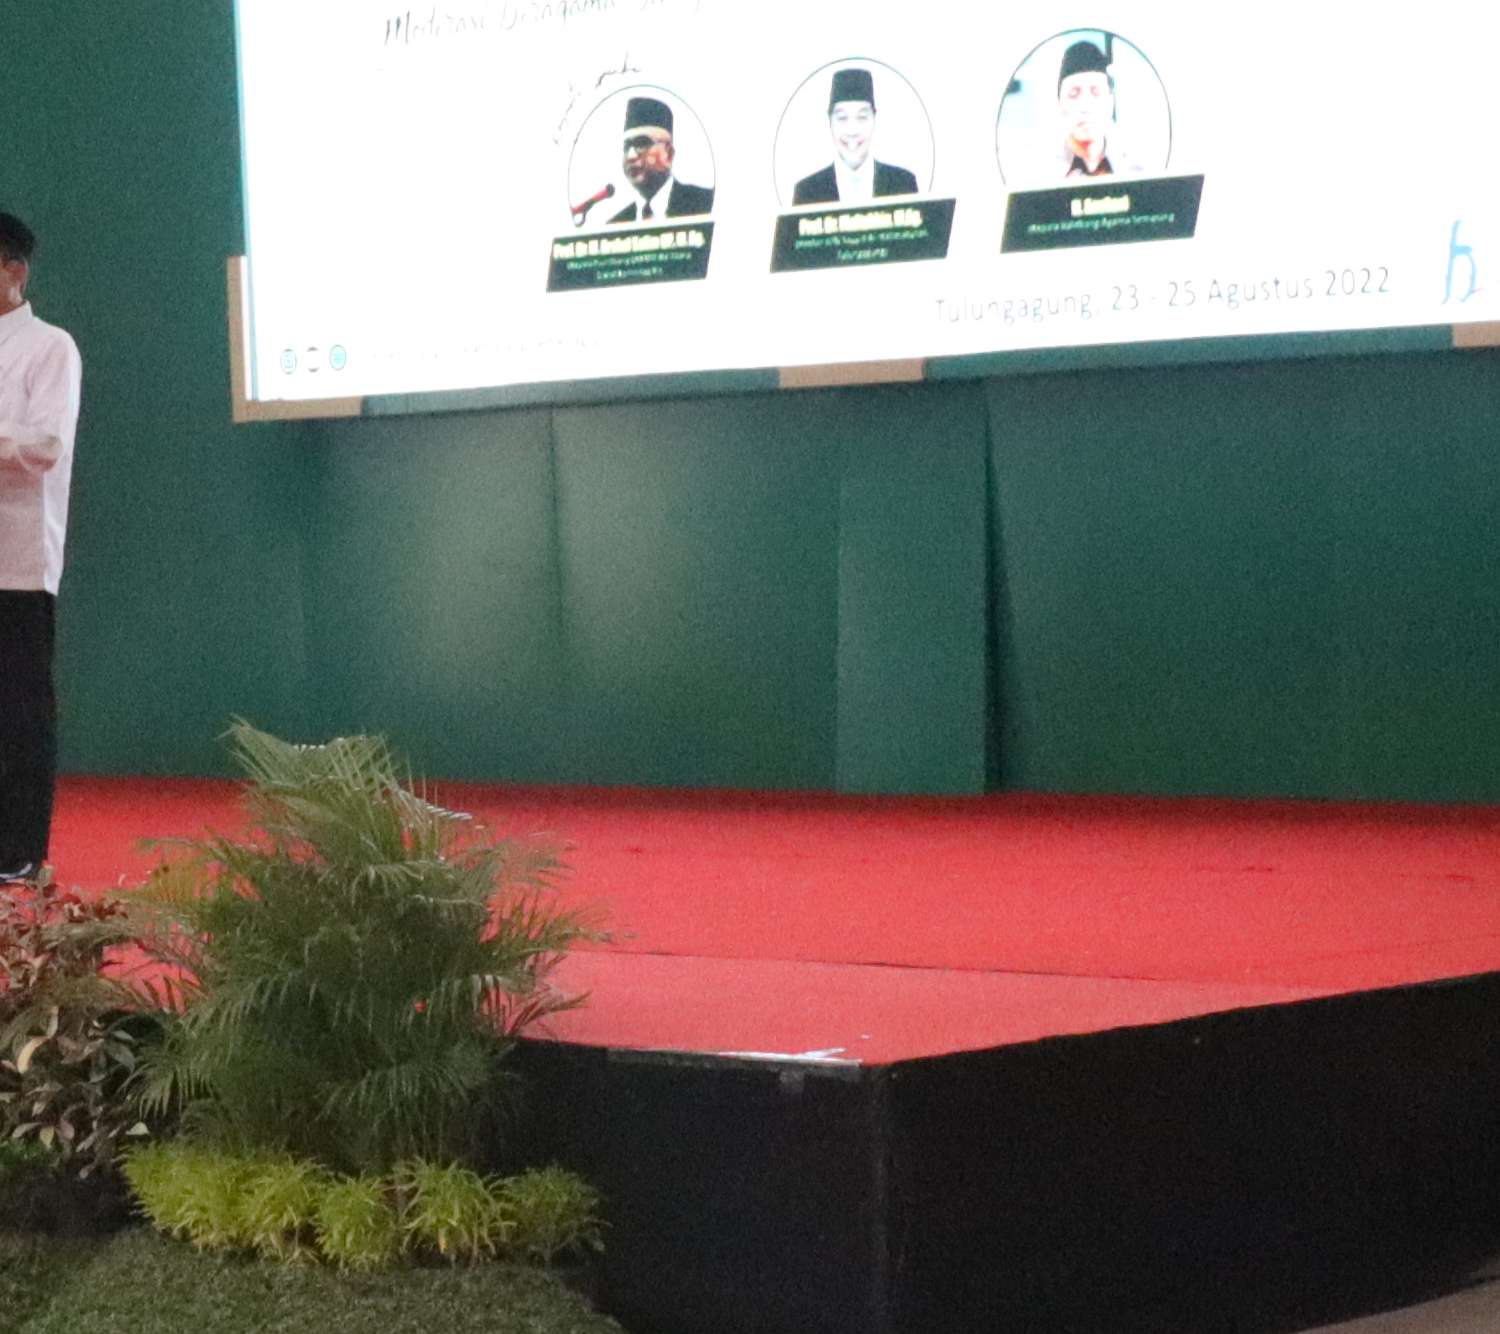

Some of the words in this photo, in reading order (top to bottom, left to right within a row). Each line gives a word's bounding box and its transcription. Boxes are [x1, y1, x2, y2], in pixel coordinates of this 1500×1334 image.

[935, 290, 1101, 326] Tulungagung,
[1111, 282, 1141, 312] 23
[1166, 278, 1197, 308] 25
[1207, 272, 1314, 310] Agustus
[1325, 266, 1391, 296] 2022
